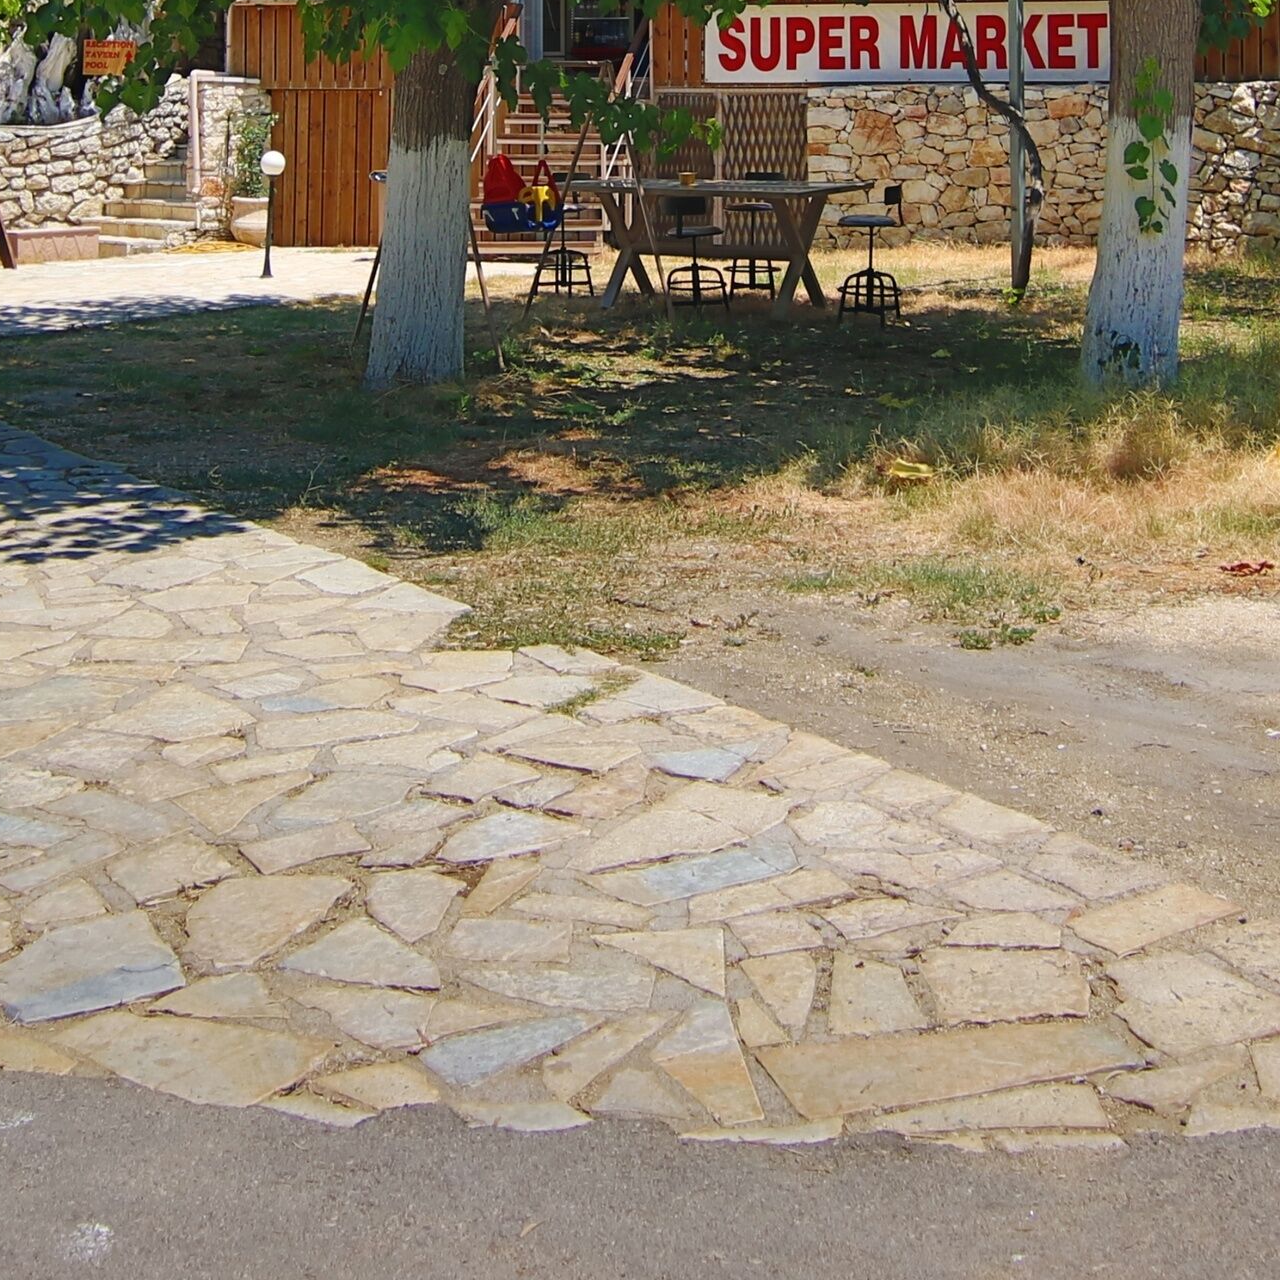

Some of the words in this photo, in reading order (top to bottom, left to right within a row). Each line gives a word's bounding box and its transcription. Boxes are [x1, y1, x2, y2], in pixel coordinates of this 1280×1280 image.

[85, 40, 134, 49] RECEPTION
[718, 15, 881, 72] SUPER
[900, 13, 1108, 70] MARKET
[85, 51, 120, 59] TAVERN
[85, 61, 109, 69] POOL
